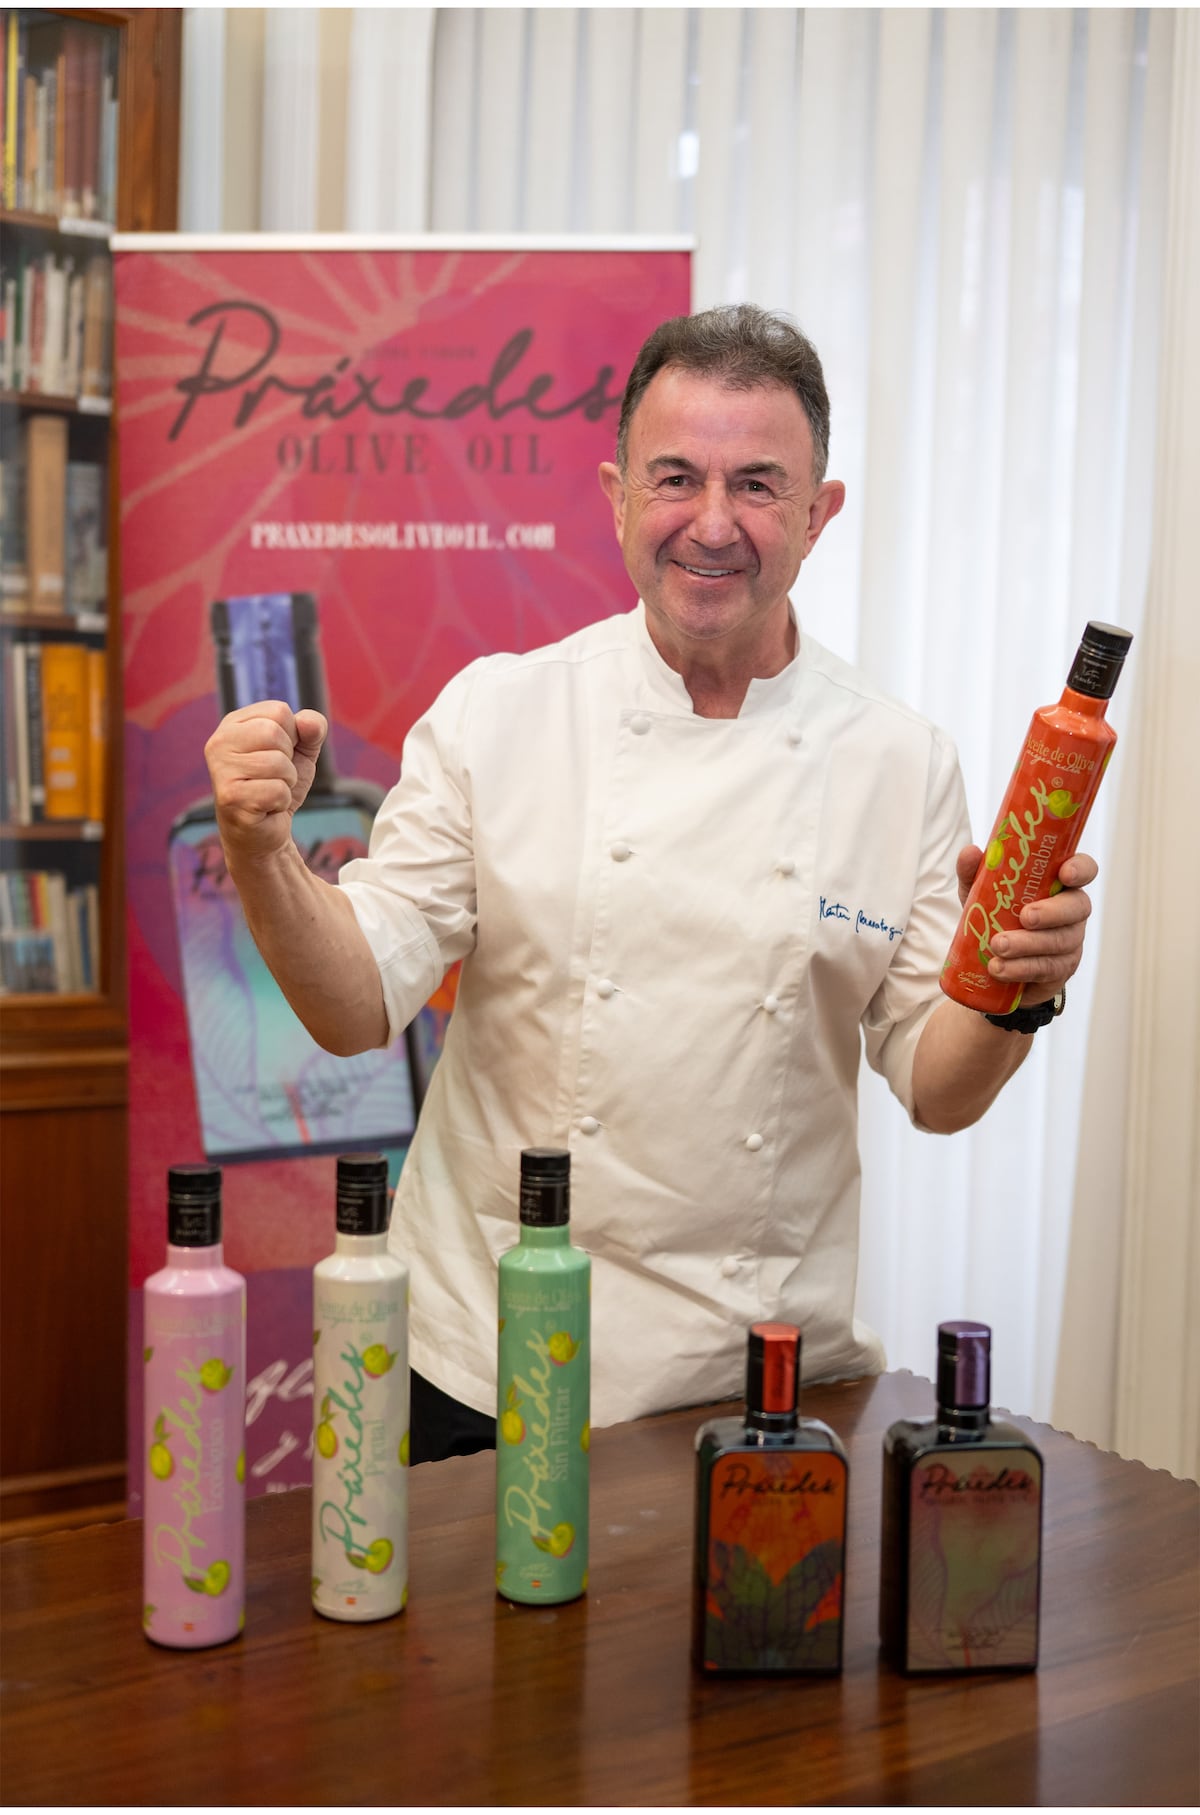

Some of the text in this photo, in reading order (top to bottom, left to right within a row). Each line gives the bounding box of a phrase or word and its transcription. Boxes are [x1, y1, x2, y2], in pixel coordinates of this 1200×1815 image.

[168, 300, 626, 442] Práxedes
[276, 434, 552, 476] OLIVE OIL
[250, 522, 556, 550] PRAXEDESOLIVEOIL.COM
[1050, 746, 1065, 763] de
[1067, 751, 1096, 772] Oliva
[1010, 833, 1058, 918] Cornicabra
